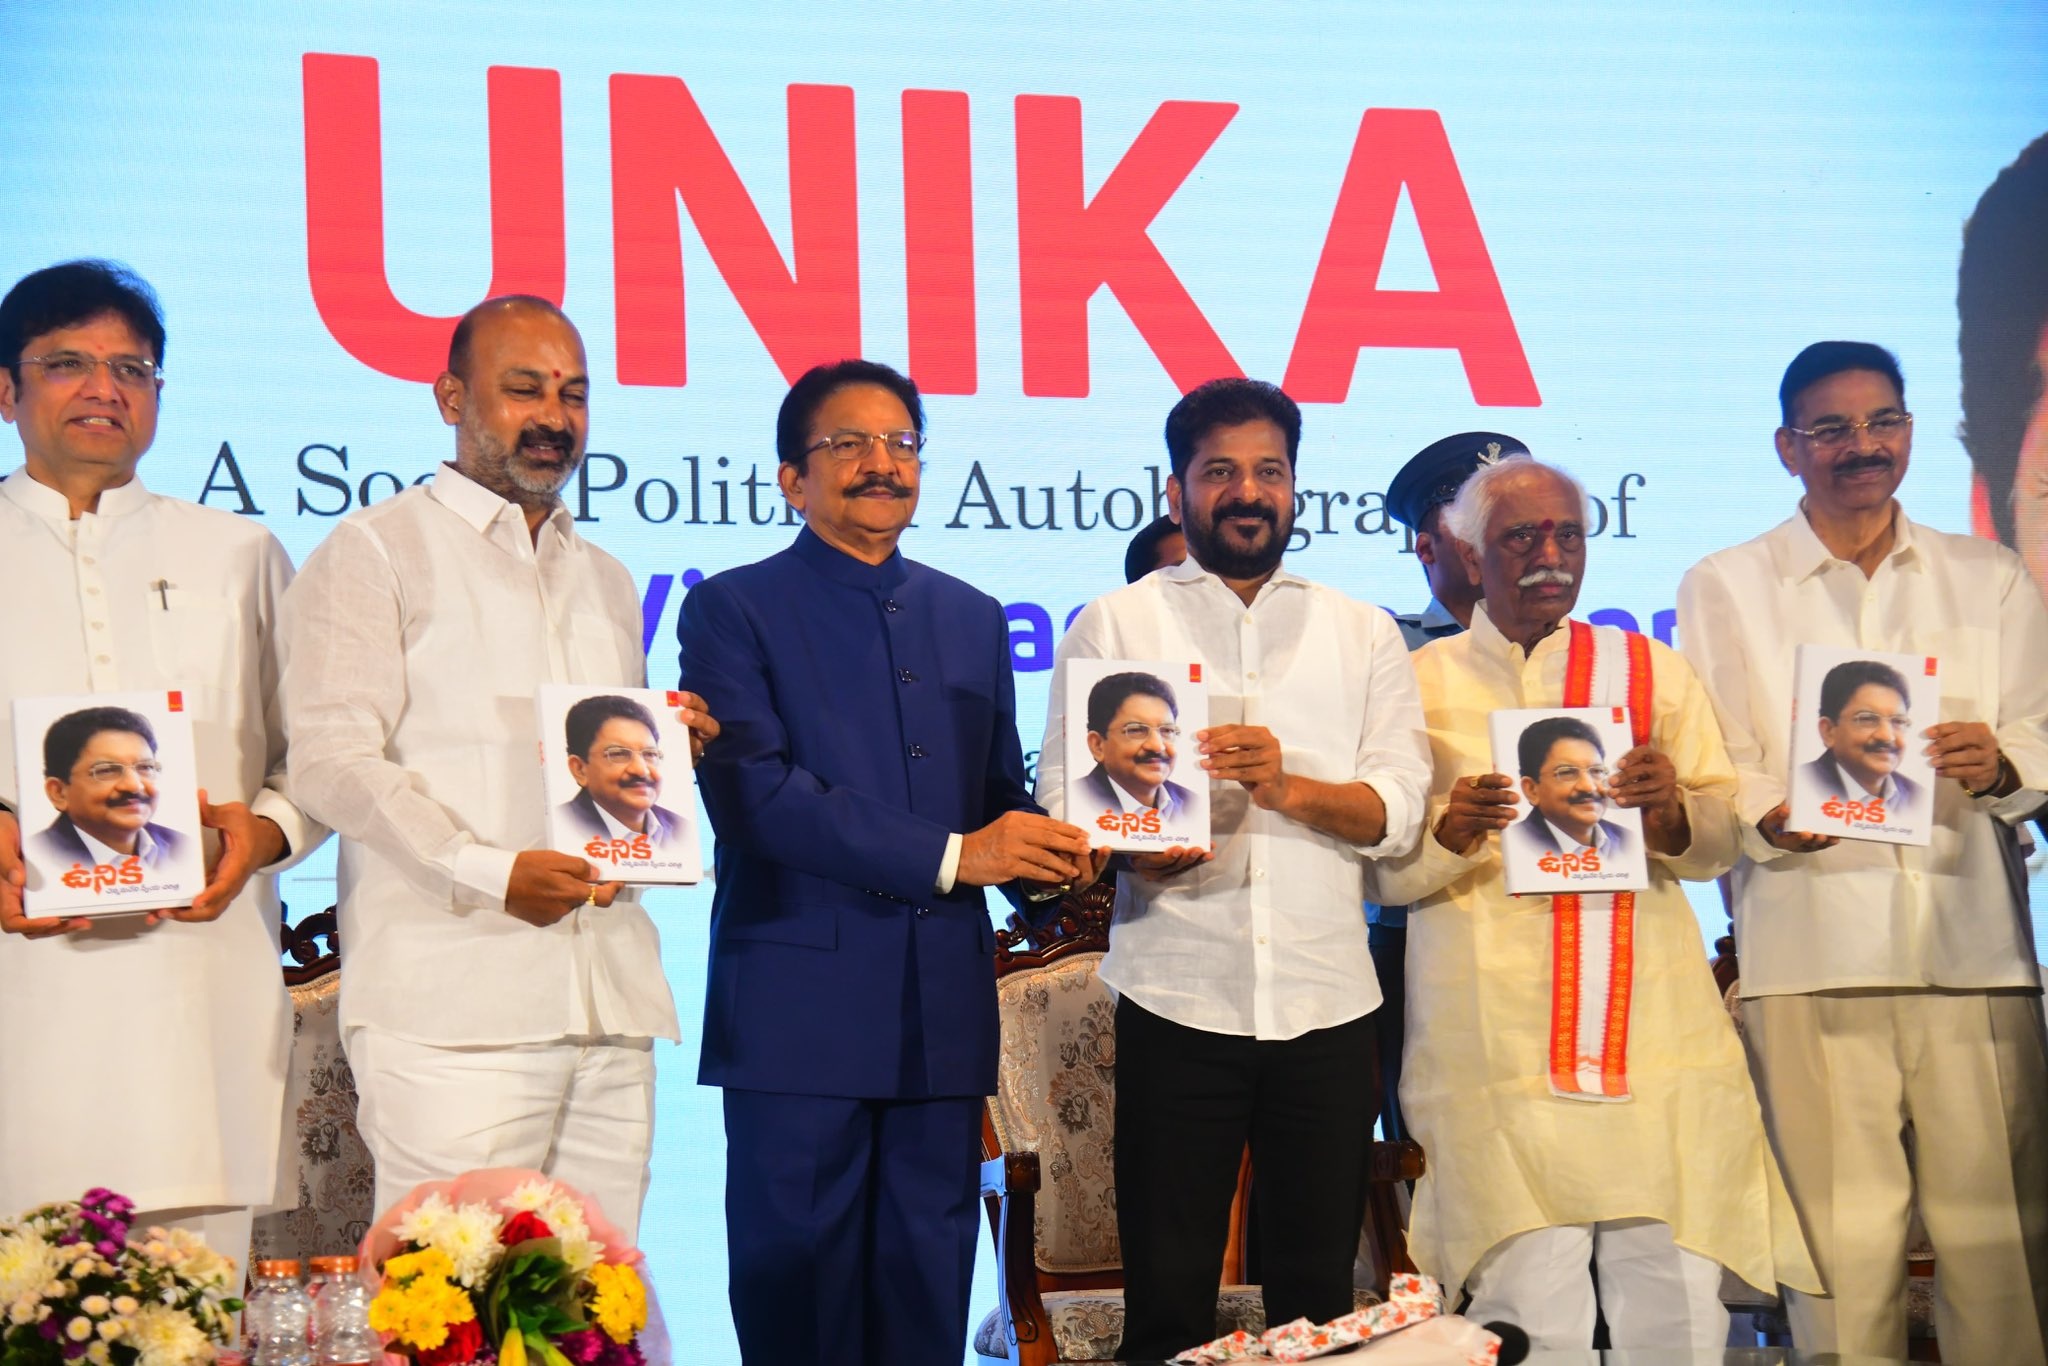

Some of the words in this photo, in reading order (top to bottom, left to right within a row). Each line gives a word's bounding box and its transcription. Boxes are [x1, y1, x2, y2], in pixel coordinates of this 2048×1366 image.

[302, 52, 1544, 407] UNIKA
[197, 441, 265, 516] A
[1096, 808, 1162, 839] ఉనిక
[1821, 794, 1886, 826] ఉనిక
[584, 833, 652, 867] ఉనిక
[1537, 847, 1601, 879] ఉనిక
[61, 855, 144, 895] ఉనిక
